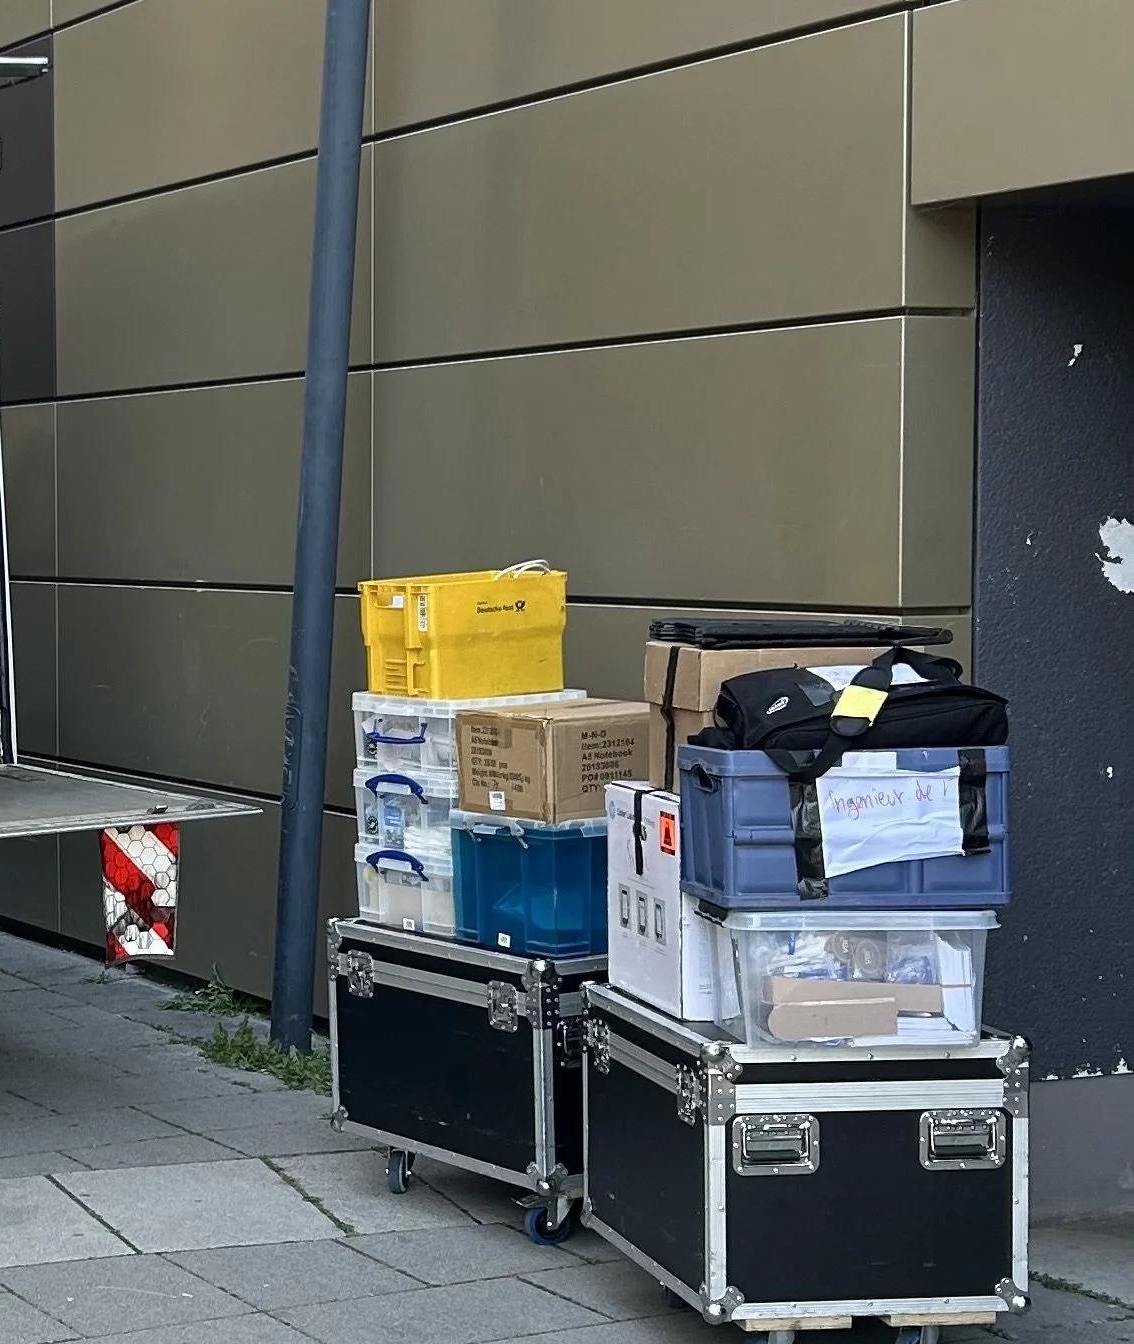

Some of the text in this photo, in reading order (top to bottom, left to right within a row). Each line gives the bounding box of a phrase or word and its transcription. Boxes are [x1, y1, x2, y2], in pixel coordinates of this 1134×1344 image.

[594, 748, 633, 761] Notebook
[828, 785, 905, 821] Ingenieur
[915, 778, 934, 802] de
